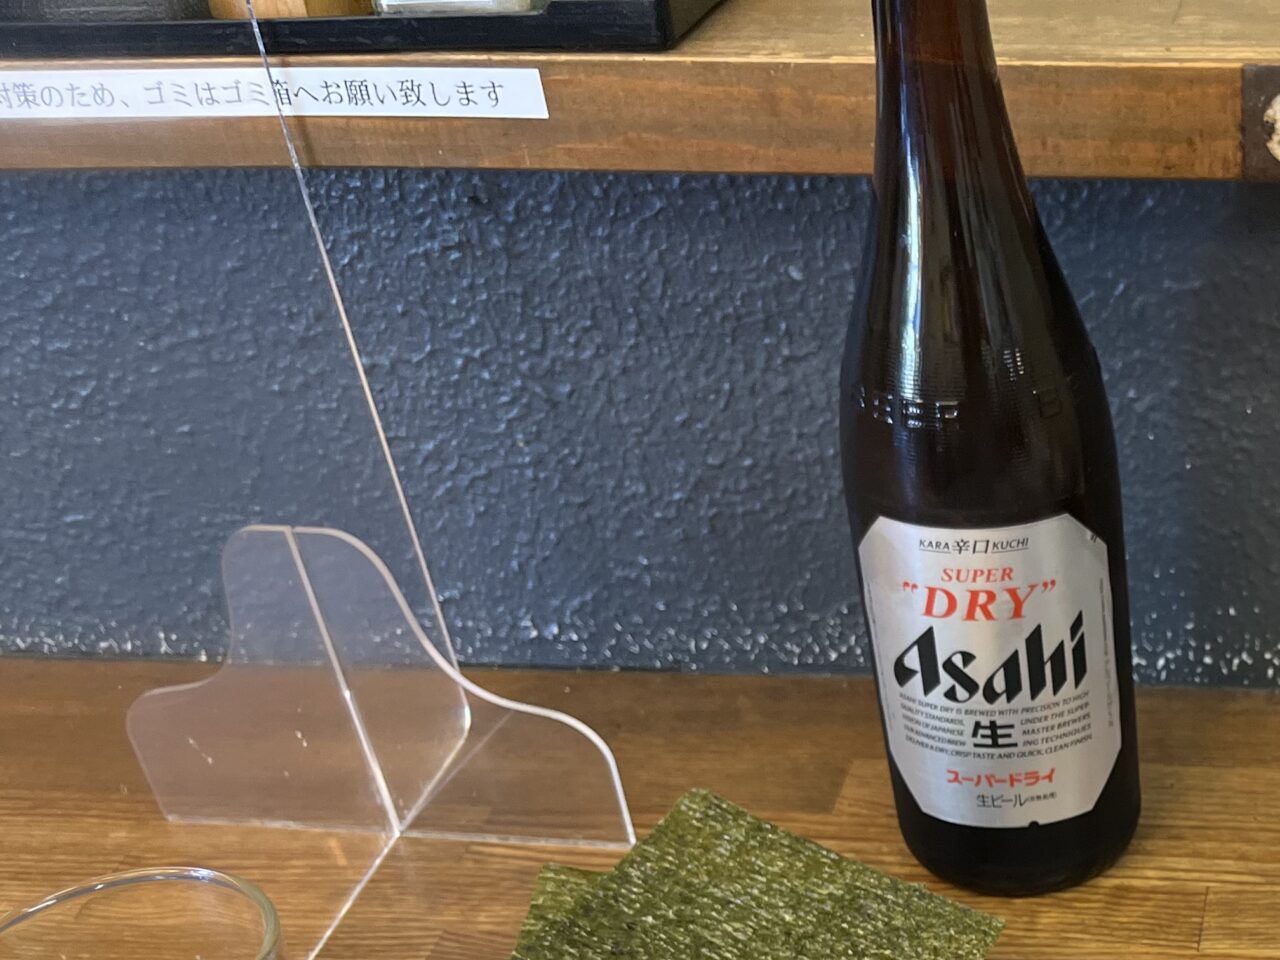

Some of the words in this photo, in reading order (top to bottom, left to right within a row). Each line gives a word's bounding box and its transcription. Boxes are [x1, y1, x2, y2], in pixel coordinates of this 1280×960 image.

[919, 538, 950, 550] KARA
[992, 537, 1029, 550] KUCHI
[941, 567, 1014, 583] SUPER
[893, 609, 1087, 705] Asahi
[918, 699, 938, 710] SUPER
[940, 705, 954, 713] DRY
[964, 709, 996, 717] BREWED
[998, 708, 1019, 716] WITH
[1021, 702, 1060, 714] PRECISION
[1020, 715, 1049, 725] UNDER
[1051, 711, 1065, 720] THE
[971, 720, 1018, 748] 生
[1022, 724, 1055, 736] MASTER
[973, 751, 994, 759] TASTE
[997, 751, 1016, 759] AND
[1045, 742, 1069, 755] CLEAN
[947, 767, 1056, 788] スーパードライ
